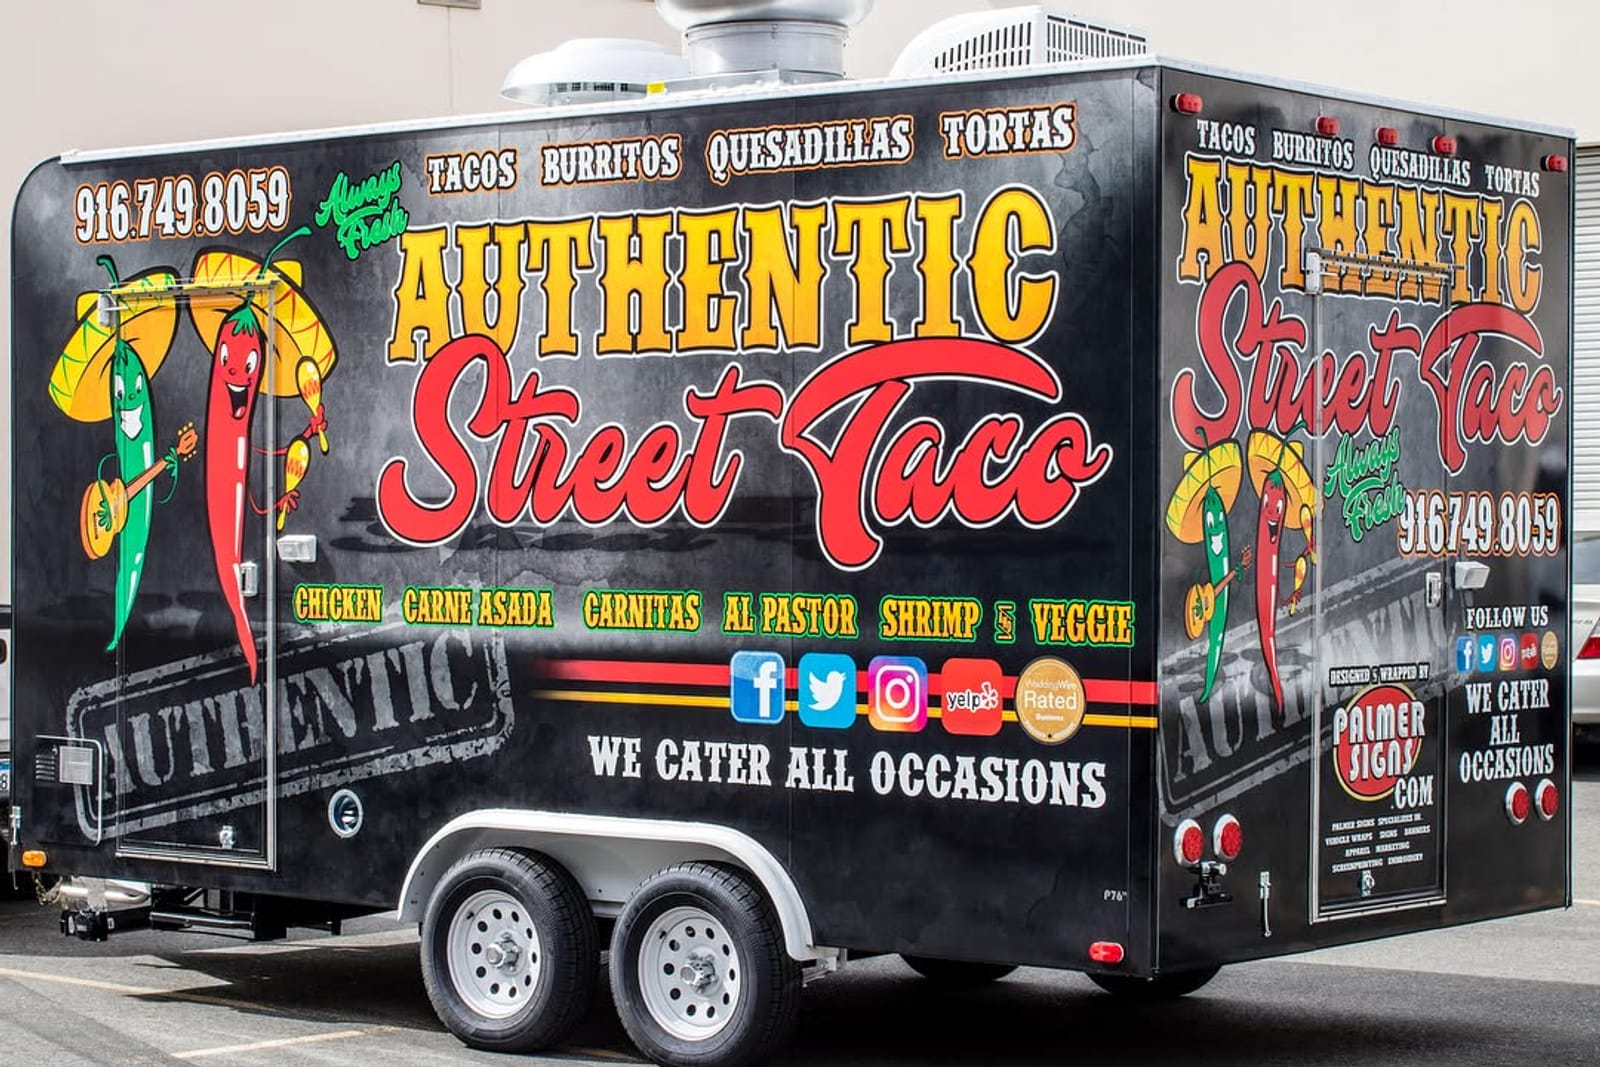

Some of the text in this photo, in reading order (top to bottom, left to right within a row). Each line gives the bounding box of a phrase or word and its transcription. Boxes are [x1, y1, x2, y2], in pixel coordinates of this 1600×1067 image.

[427, 103, 1077, 194] TACOS BURRITOS QUESADILLAS TORTAS
[1197, 119, 1540, 198] TACOS BURRITOS QUESADILLAS TORTAS
[75, 169, 291, 243] 916.749.8059
[315, 161, 401, 227] Always
[337, 198, 408, 260] Fresh
[1178, 154, 1542, 314] AUTHENTIC
[386, 183, 1059, 367] AUTHENTIC
[1171, 260, 1563, 477] Street Taco
[377, 332, 1114, 572] Street Taco
[1324, 427, 1400, 498] Always
[1343, 470, 1407, 541] Fresh
[294, 585, 383, 623] CHICKEN
[402, 586, 473, 626] CARNE
[478, 588, 555, 628] ASADA
[582, 591, 703, 633] CARNITAS
[724, 594, 755, 635] AL
[761, 594, 859, 639] PASTOR
[880, 596, 982, 643] SHRIMP
[1031, 600, 1136, 647] VEGGIE
[1466, 604, 1550, 630] FOLLOW US
[97, 628, 478, 799] AUTHENTIC
[947, 689, 983, 713] yelp
[1024, 690, 1078, 711] Rated
[1333, 701, 1426, 746] PALMER
[1465, 678, 1550, 714] WE CATER
[1489, 714, 1520, 746] ALL
[588, 735, 1107, 809] WE CATER ALL OCCASIONS
[1349, 738, 1413, 782] SIGNS
[1460, 743, 1554, 784] OCCASIONS
